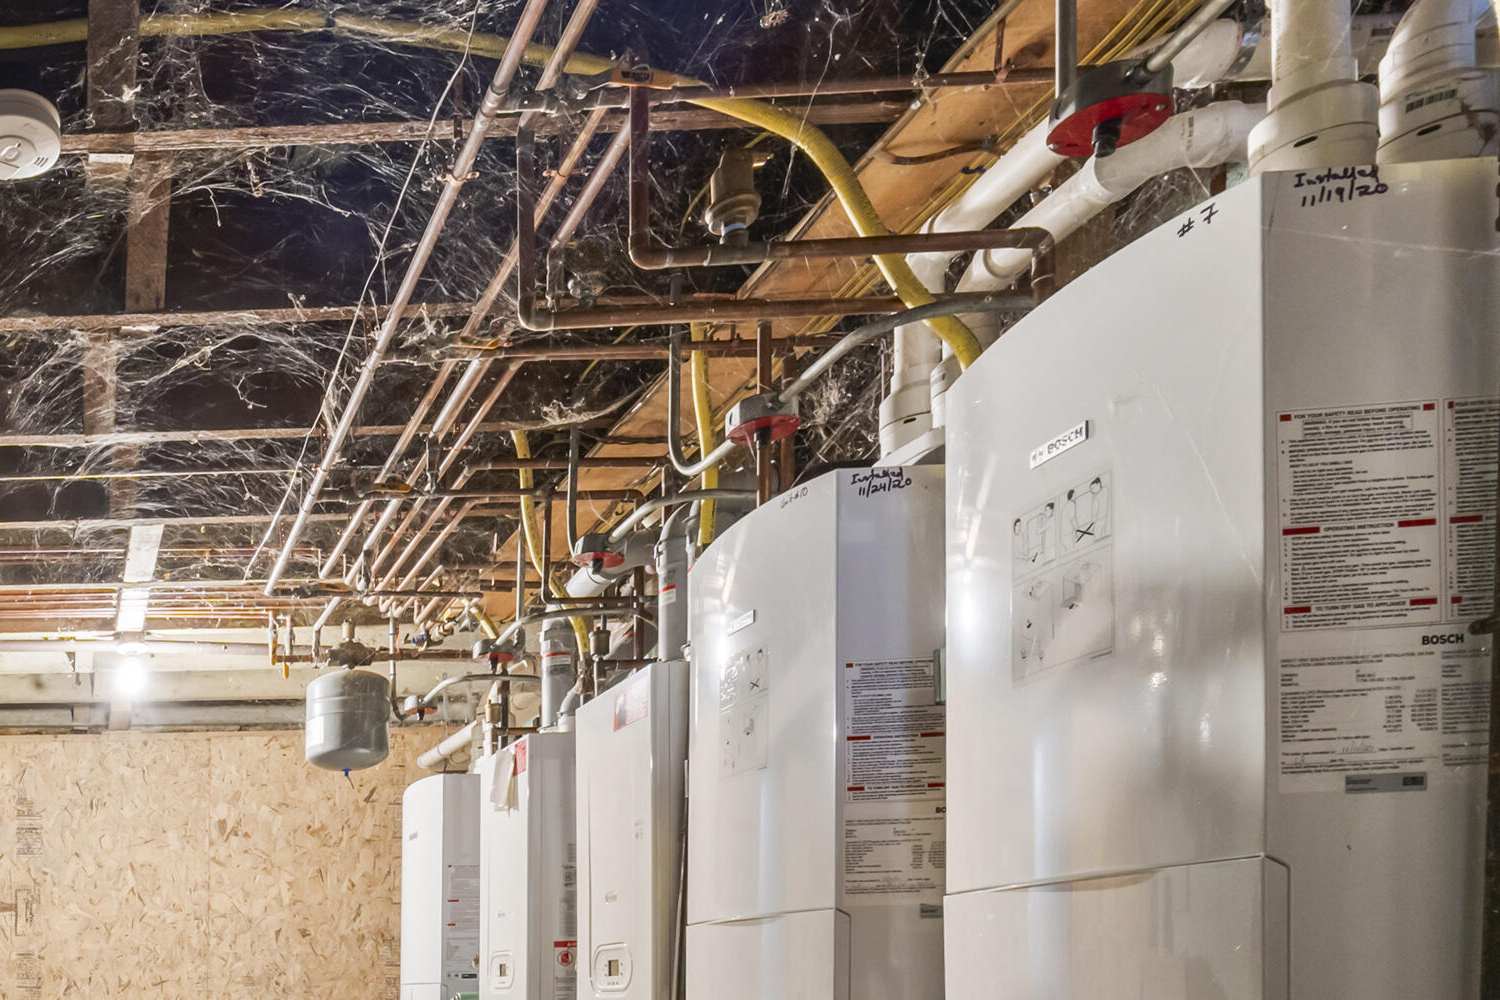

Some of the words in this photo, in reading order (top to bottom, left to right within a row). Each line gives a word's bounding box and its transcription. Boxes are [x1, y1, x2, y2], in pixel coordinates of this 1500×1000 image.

[1294, 165, 1380, 188] Installed
[1301, 179, 1389, 207] 11/19/20
[1324, 410, 1346, 418] SAFETY
[1047, 425, 1084, 455] BOSCH
[851, 466, 904, 486] Installed
[858, 477, 912, 498] 11/24/20
[1421, 633, 1465, 646] BOSCH
